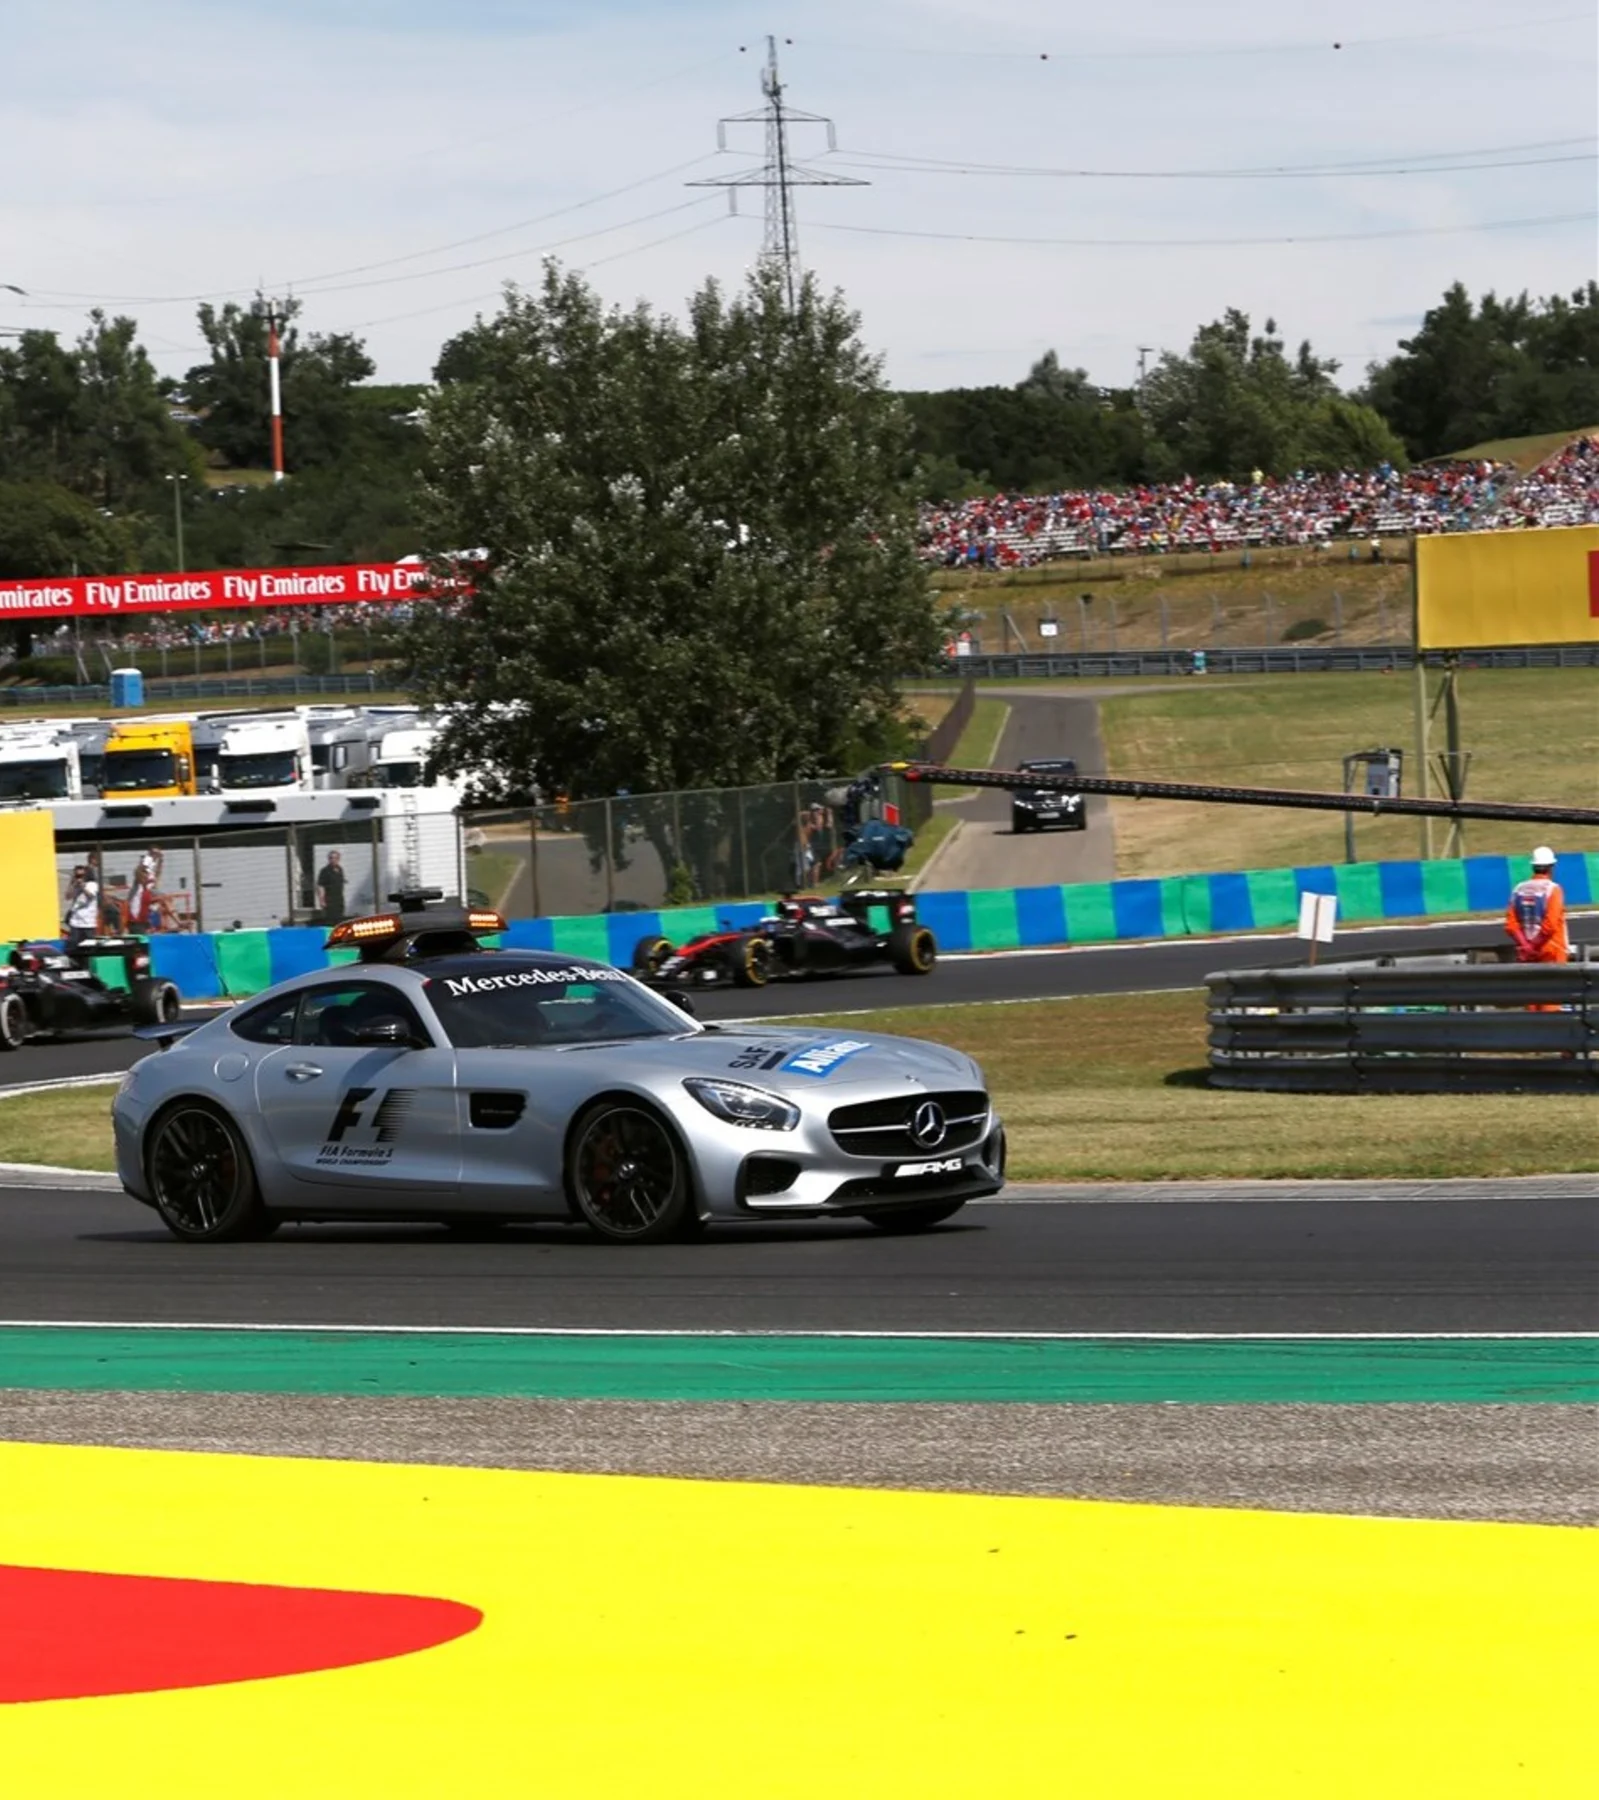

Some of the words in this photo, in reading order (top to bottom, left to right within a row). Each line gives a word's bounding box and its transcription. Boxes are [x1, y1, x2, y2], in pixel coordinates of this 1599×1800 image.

[85, 582, 120, 608] Fly
[123, 579, 212, 603] Emirates
[223, 576, 256, 602] Fly
[260, 572, 346, 597] Emirates
[357, 569, 393, 595] Fly
[443, 966, 627, 997] Mercedes-Benz
[789, 1040, 872, 1074] Allianz
[327, 1087, 417, 1142] F1
[319, 1145, 339, 1157] FIA
[340, 1146, 385, 1158] Formula
[920, 1158, 962, 1175] AMG
